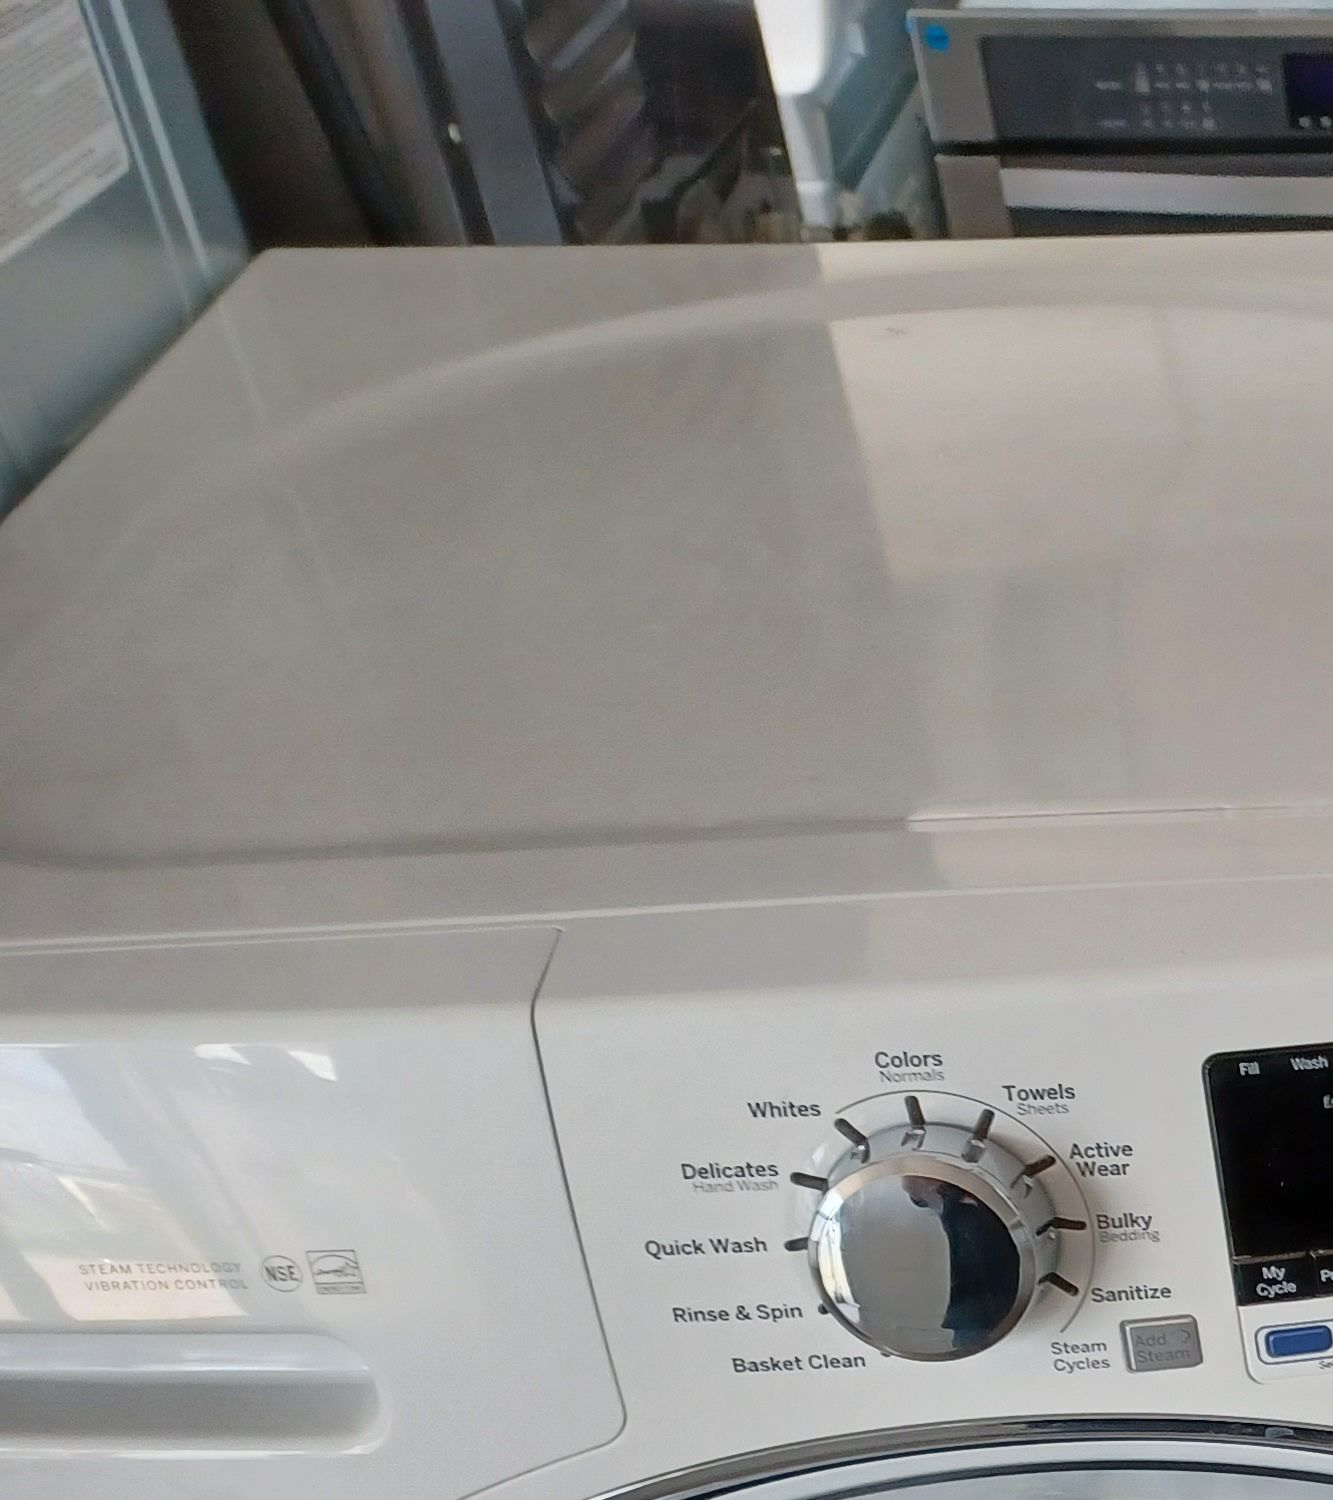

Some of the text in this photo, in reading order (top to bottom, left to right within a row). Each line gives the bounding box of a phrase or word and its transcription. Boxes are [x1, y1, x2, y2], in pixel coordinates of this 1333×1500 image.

[874, 1051, 943, 1070] Colors
[1239, 1062, 1260, 1076] Fill
[1290, 1055, 1329, 1072] Wash
[879, 1068, 945, 1082] Normals
[1002, 1082, 1076, 1104] Towels
[747, 1101, 821, 1120] Whites
[1015, 1101, 1069, 1116] Sheets
[1069, 1141, 1133, 1162] Active
[681, 1160, 779, 1181] Delicates
[1076, 1159, 1130, 1179] Wear
[737, 1176, 780, 1190] Wash
[1096, 1211, 1153, 1233] Bulky
[646, 1236, 768, 1258] Quick Wash
[78, 1262, 241, 1275] STEAM TECHNOLOGY
[1261, 1266, 1286, 1281] My
[84, 1278, 248, 1292] VIBRATION CONTROL
[1091, 1282, 1172, 1304] Sanitize
[1256, 1281, 1297, 1298] Cycle
[672, 1302, 803, 1323] Rinse & Spin
[1050, 1339, 1108, 1356] Steam
[1136, 1333, 1166, 1346] Add
[731, 1350, 866, 1375] Basket Clean
[1053, 1356, 1110, 1374] Cycles
[1137, 1350, 1191, 1363] Steam
